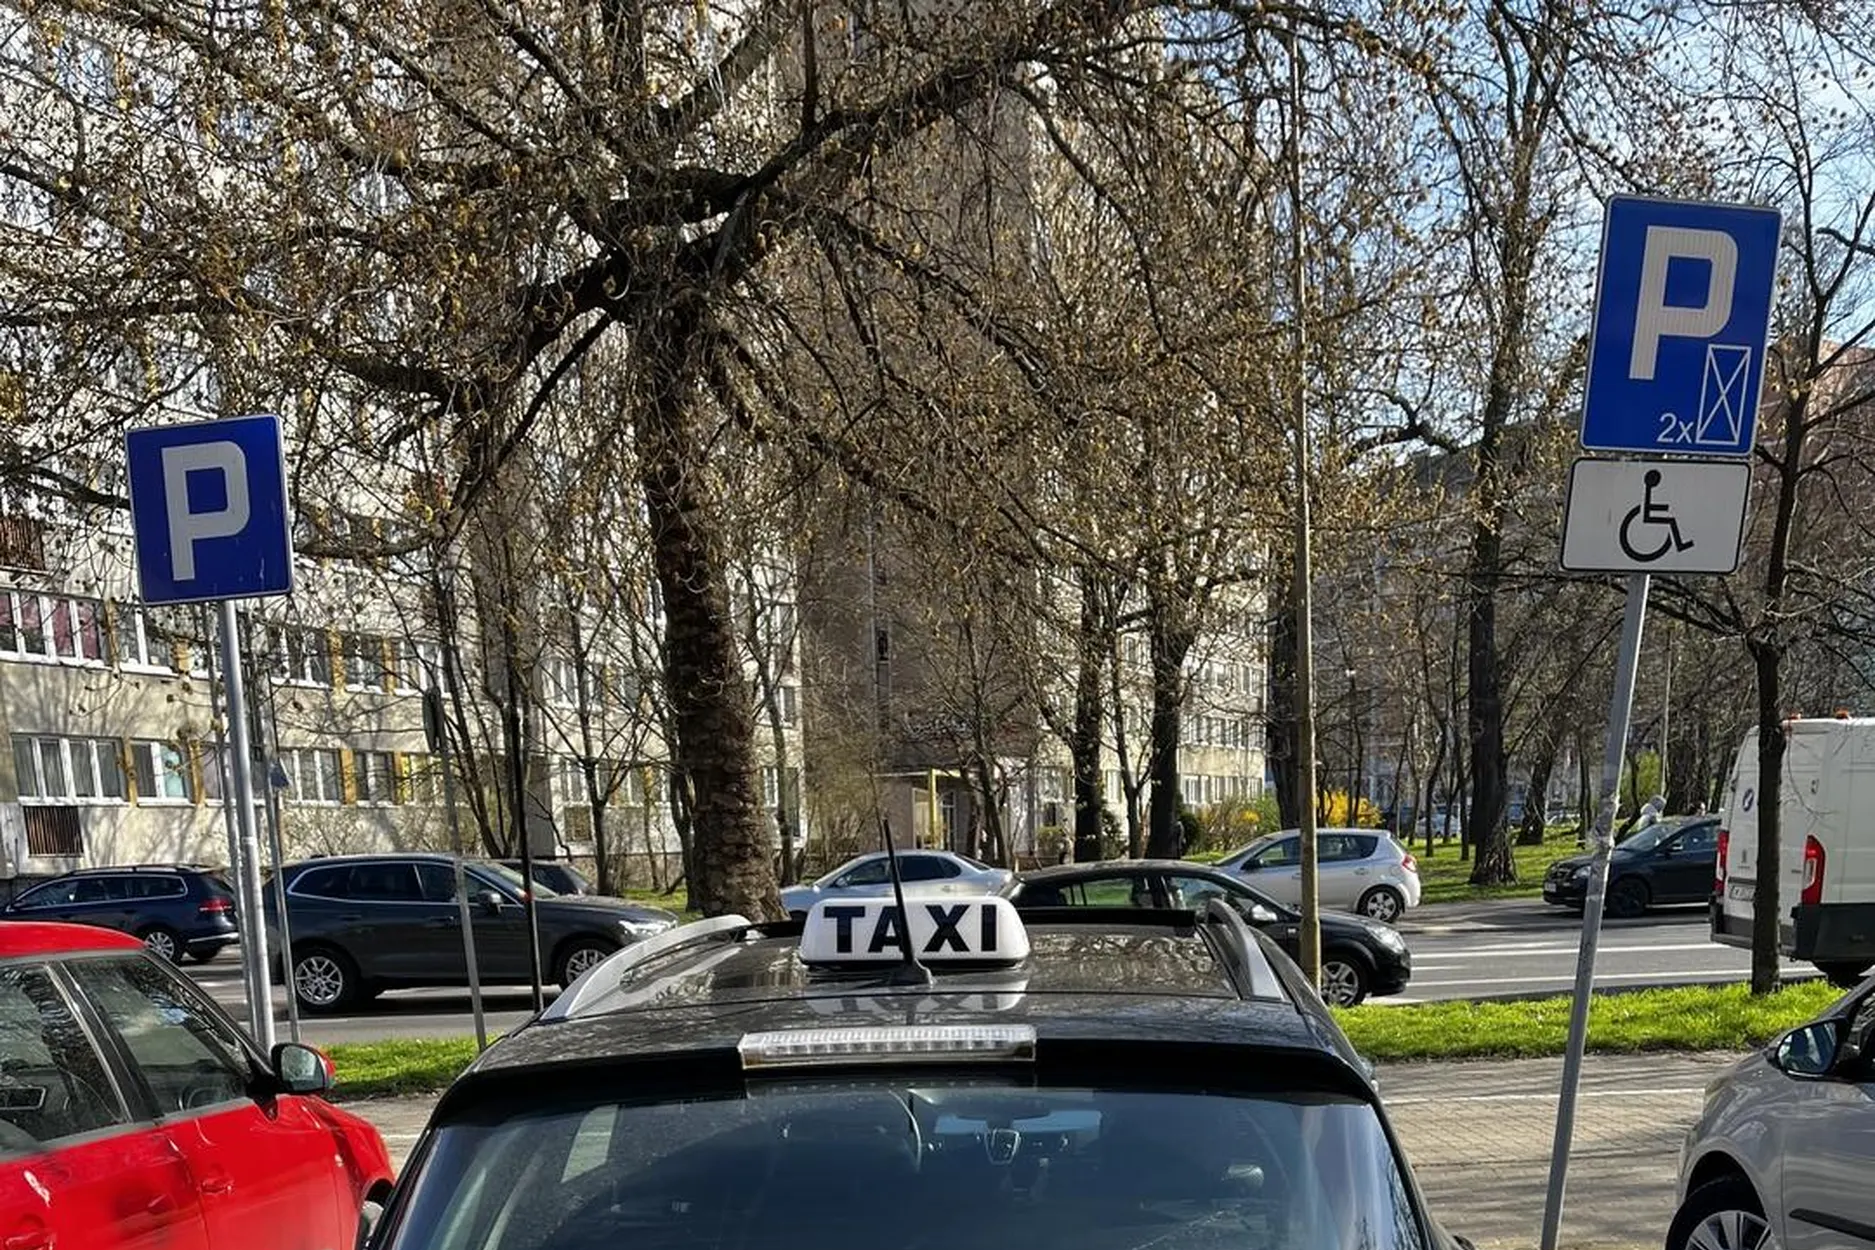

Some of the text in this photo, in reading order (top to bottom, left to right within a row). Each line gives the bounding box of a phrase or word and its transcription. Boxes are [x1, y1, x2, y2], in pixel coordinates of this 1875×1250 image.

[1628, 224, 1739, 381] P
[1656, 412, 1694, 444] 2x
[161, 440, 250, 581] P
[823, 904, 998, 953] TAXI
